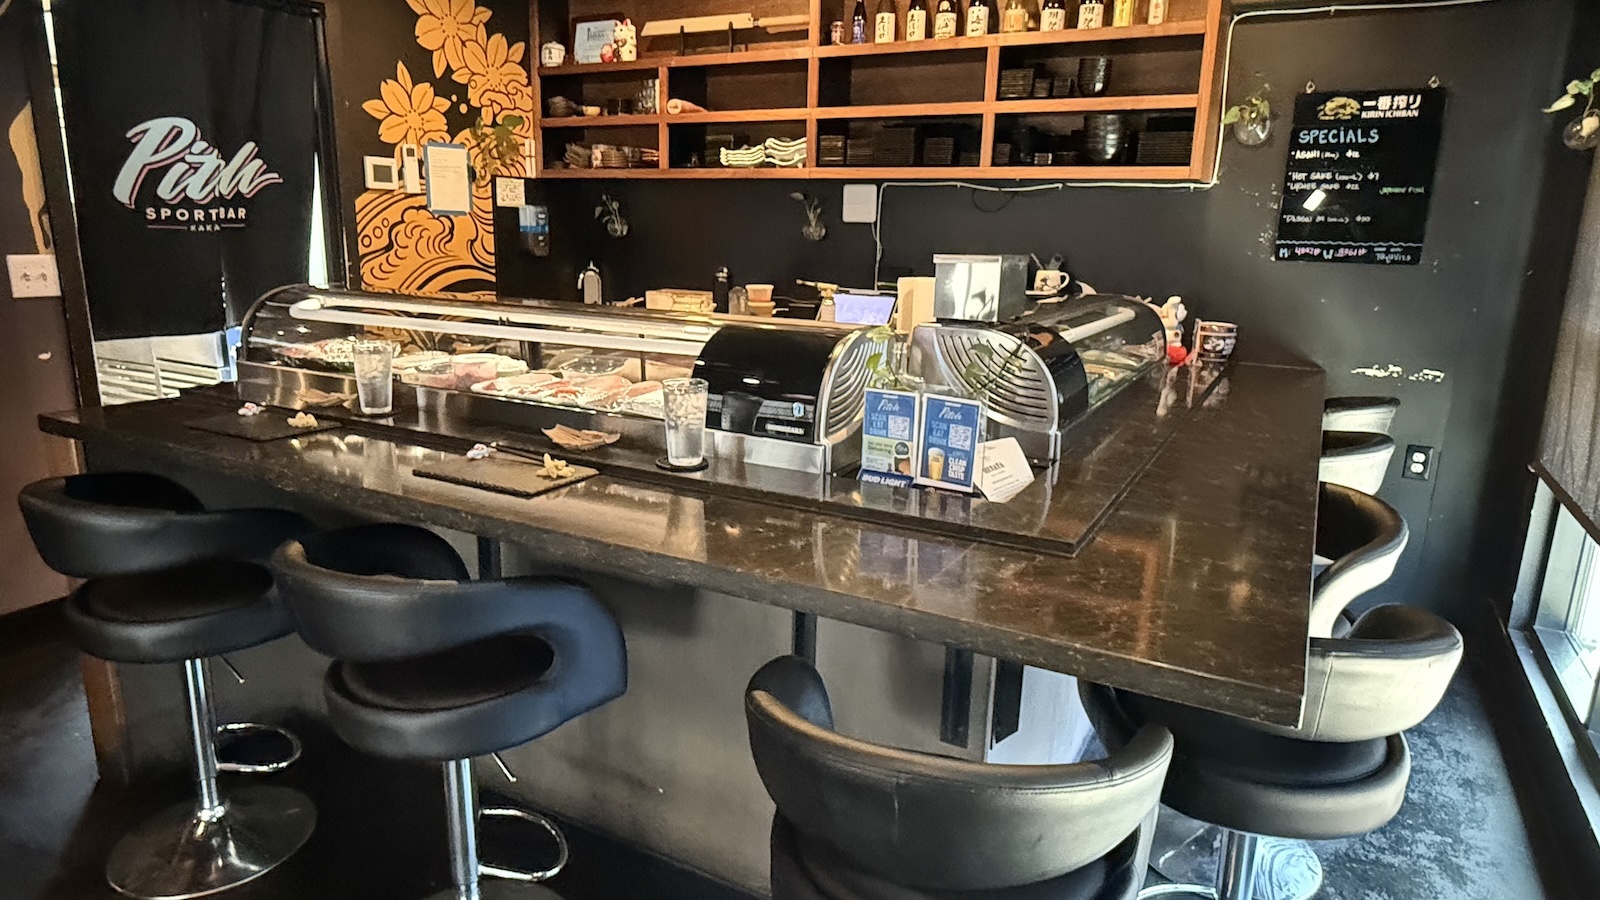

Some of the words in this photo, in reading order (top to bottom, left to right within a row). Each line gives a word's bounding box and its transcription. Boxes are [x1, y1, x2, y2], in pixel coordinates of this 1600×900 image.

[1363, 94, 1422, 109] 一番搾り
[1361, 110, 1384, 119] KIRIN
[1385, 109, 1419, 118] ICHIBAN
[1298, 127, 1379, 144] SPECIALS
[1295, 150, 1320, 160] ASAHI
[1292, 172, 1308, 181] HOT
[1310, 172, 1332, 180] SAKE
[146, 207, 218, 221] SPORT
[219, 206, 246, 219] BAR
[931, 421, 948, 429] SCAN
[948, 457, 967, 467] CLEAN
[949, 464, 966, 474] CRISP
[948, 470, 965, 480] TASTE
[862, 474, 881, 483] BUD
[881, 476, 906, 488] LIGHT
